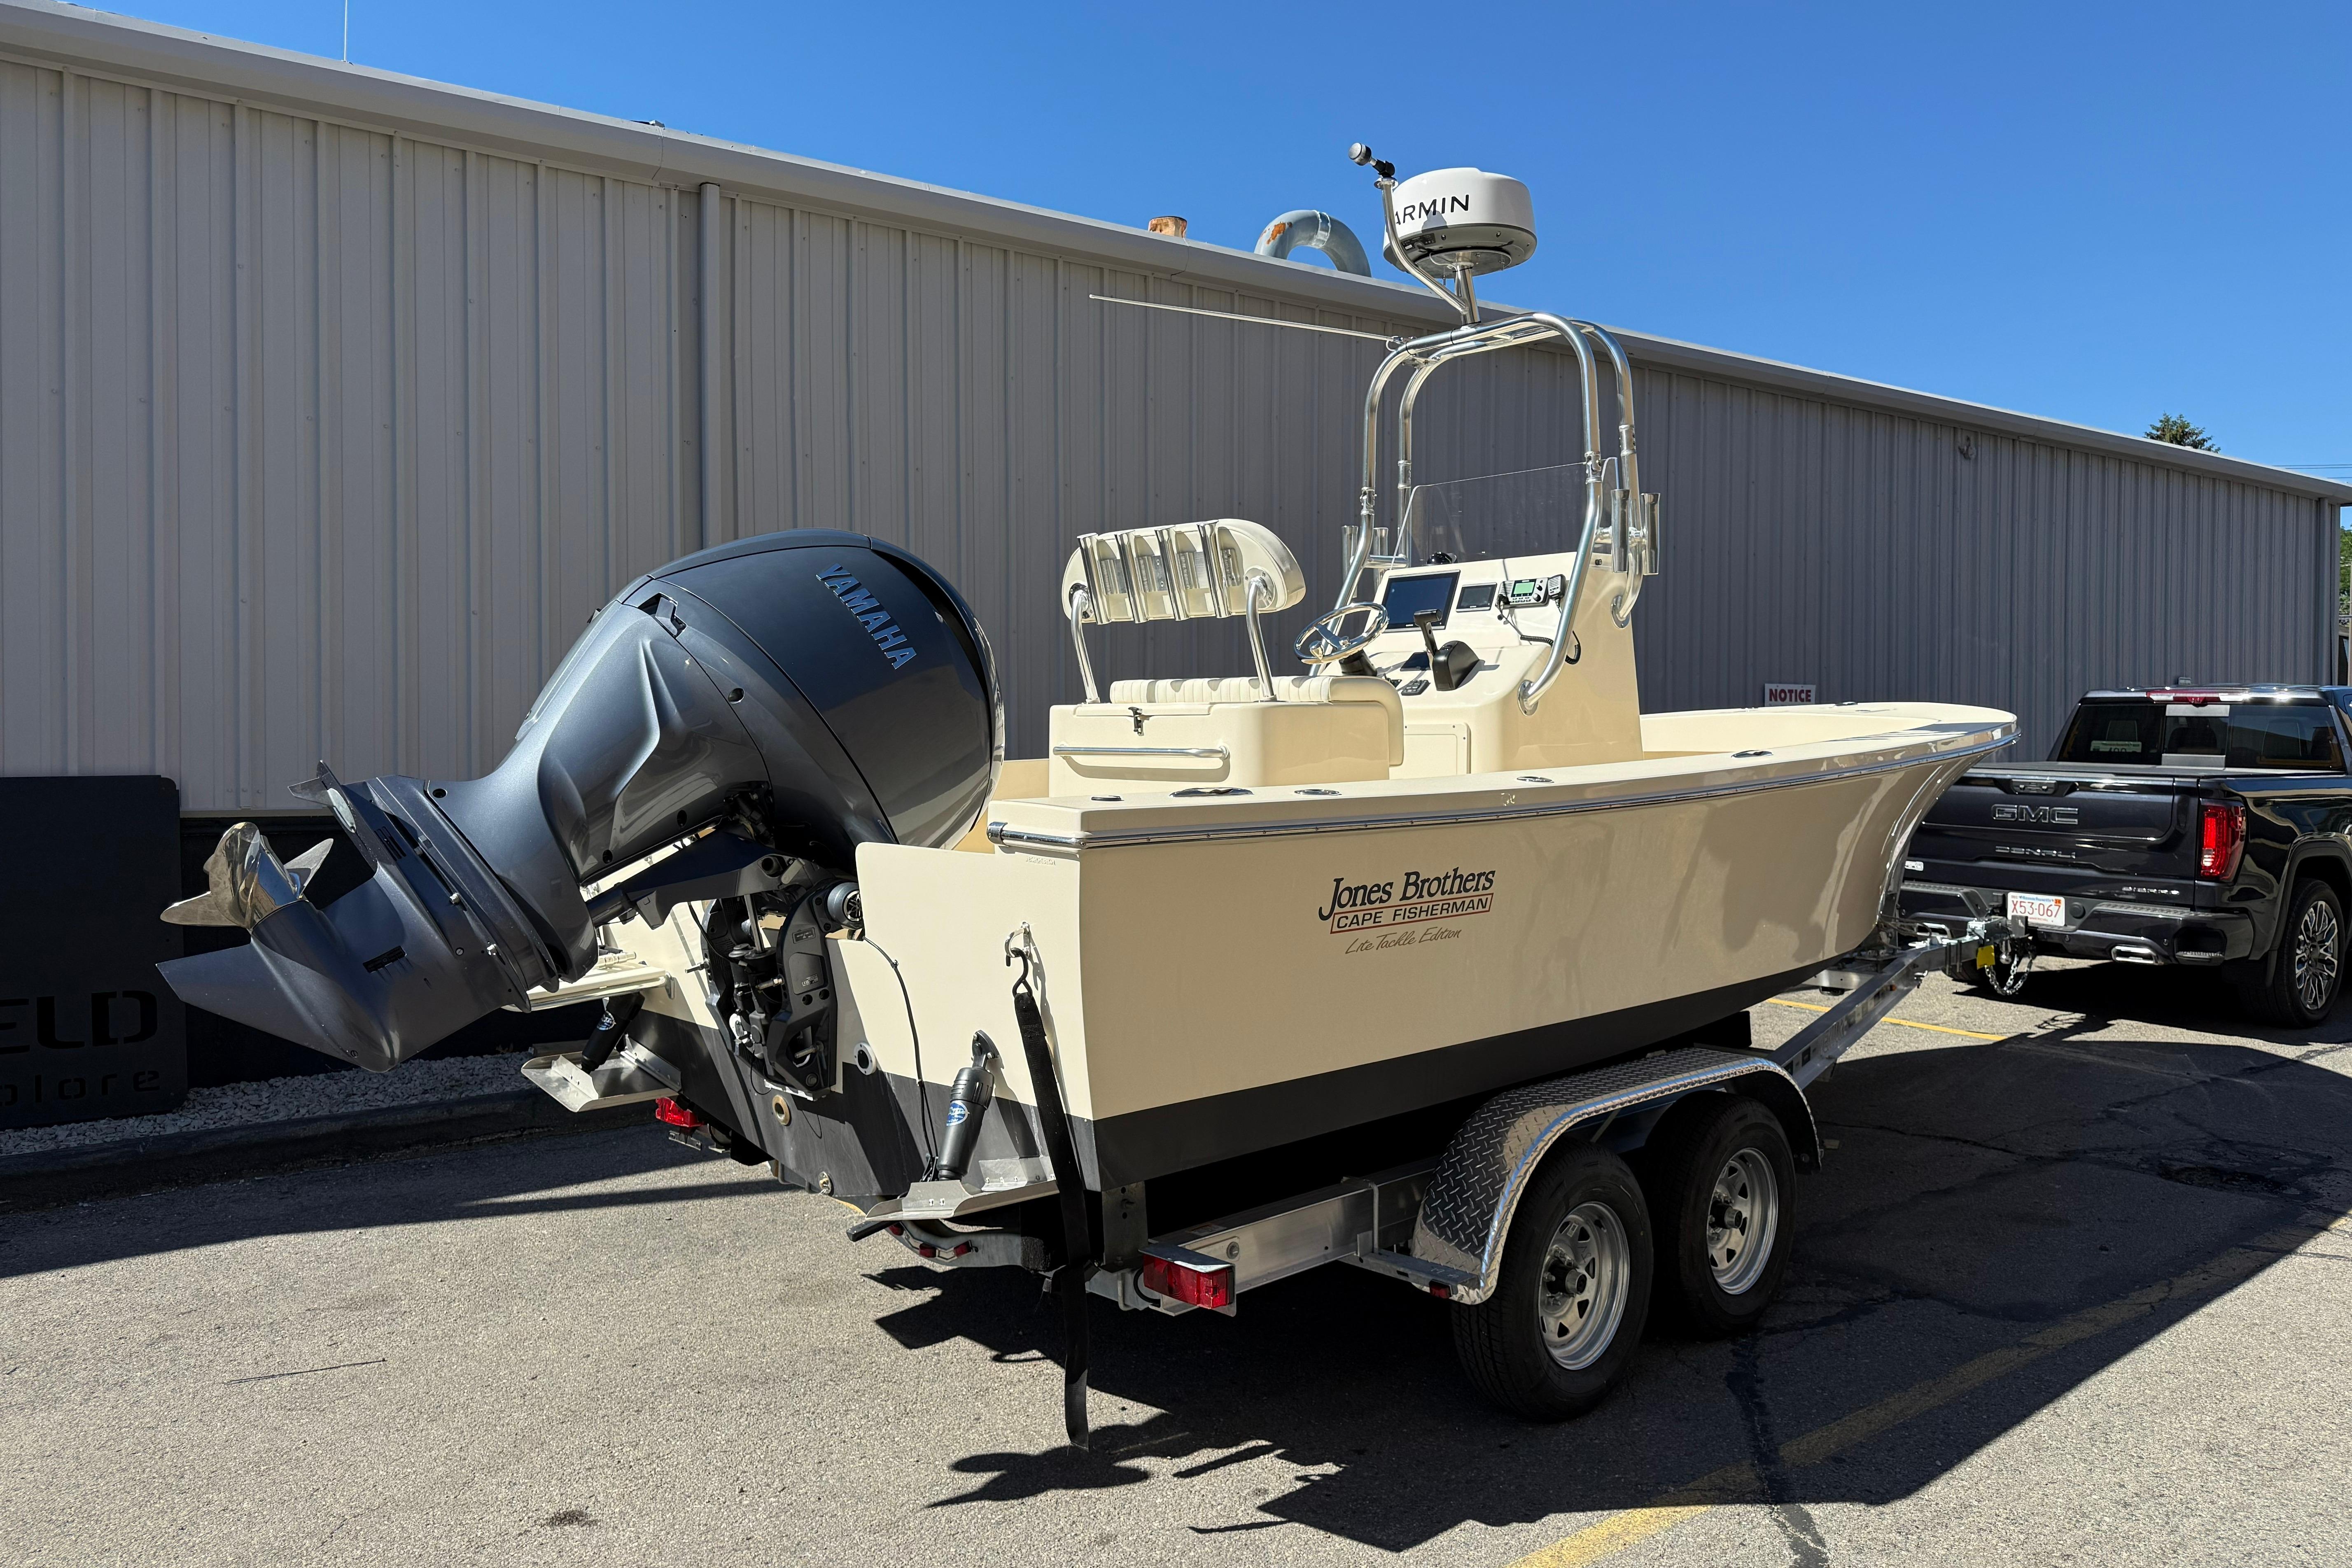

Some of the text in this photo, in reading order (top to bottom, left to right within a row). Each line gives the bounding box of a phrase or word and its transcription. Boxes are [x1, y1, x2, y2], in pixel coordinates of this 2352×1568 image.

[1395, 194, 1469, 225] ARMIN
[816, 563, 917, 670] YAMAHA
[1769, 688, 1811, 702] NOTICE
[1991, 804, 2078, 824] GMC
[1318, 867, 1496, 921] Jones Brothers
[1337, 897, 1489, 929] CAPE FISHERMAN
[1345, 926, 1462, 954] Lite Tackle Edition
